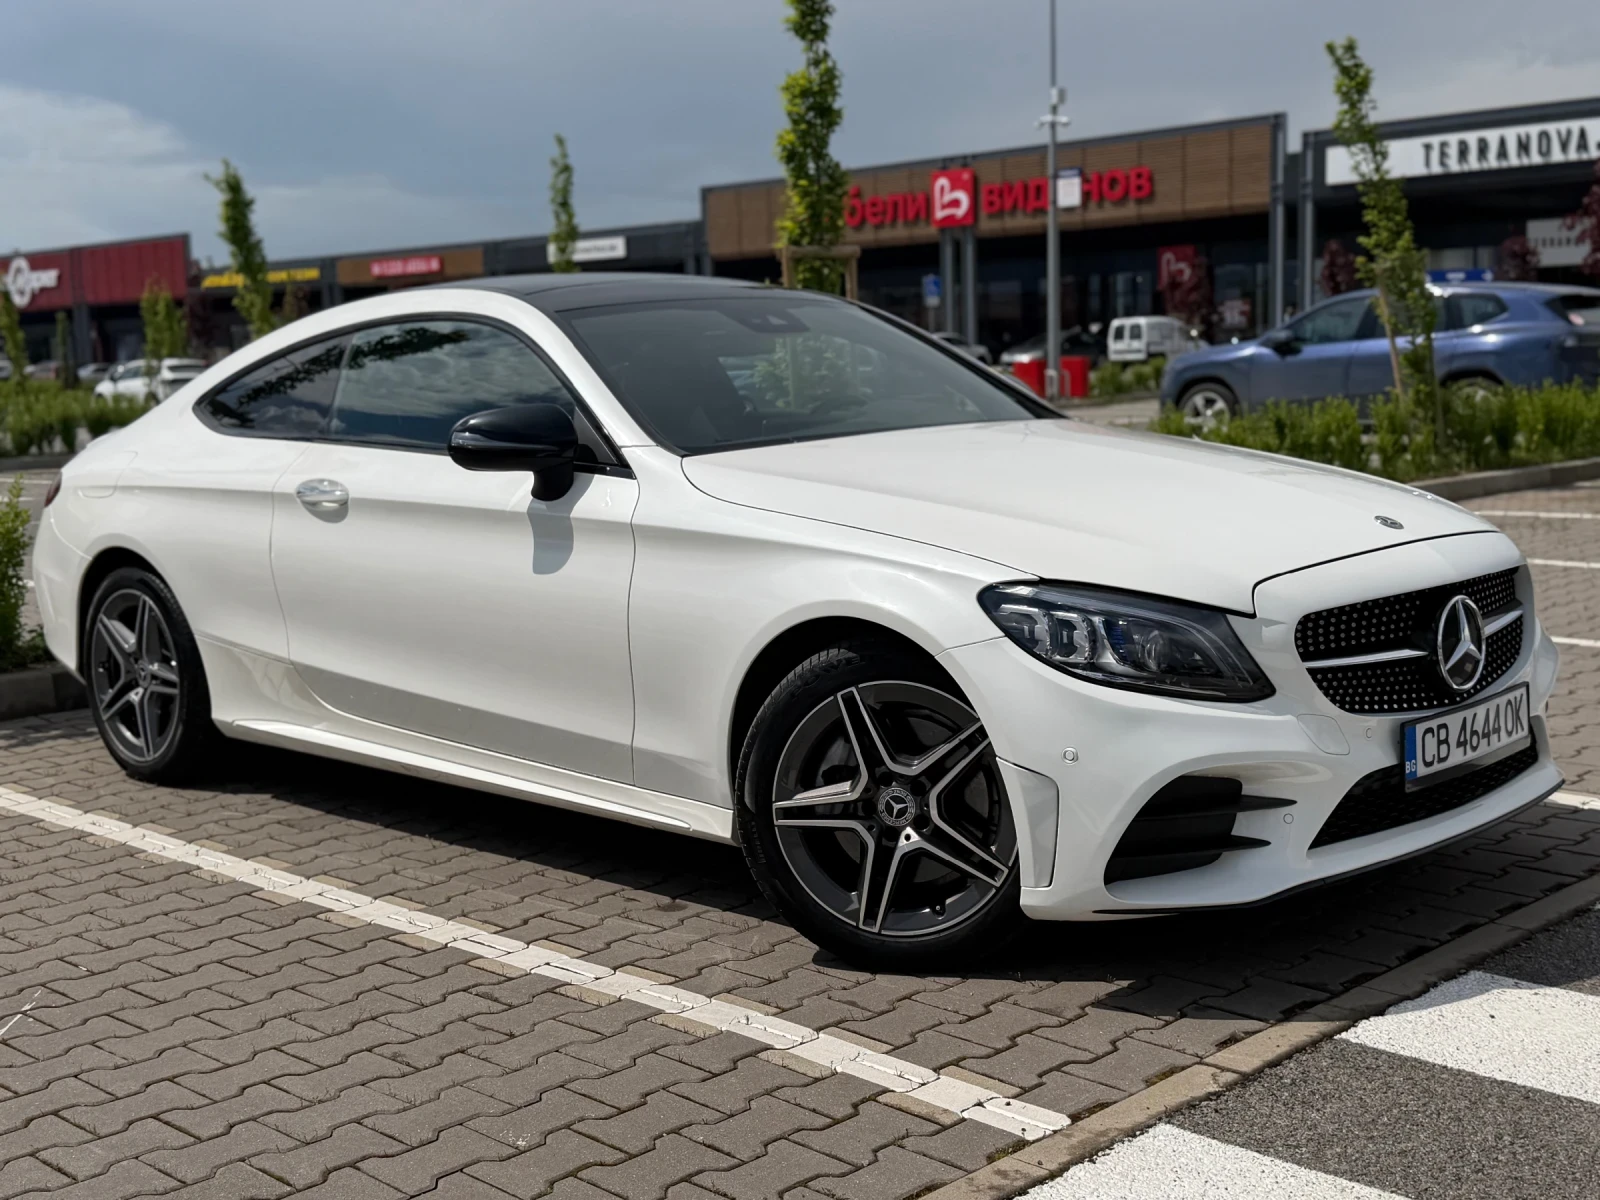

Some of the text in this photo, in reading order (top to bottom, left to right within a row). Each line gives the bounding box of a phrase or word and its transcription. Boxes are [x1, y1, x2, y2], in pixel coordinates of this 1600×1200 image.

[1422, 125, 1589, 169] TERRANOVA
[844, 165, 1153, 227] бели виднов
[1421, 693, 1525, 768] CB 4644 OK
[1405, 759, 1417, 774] BG
